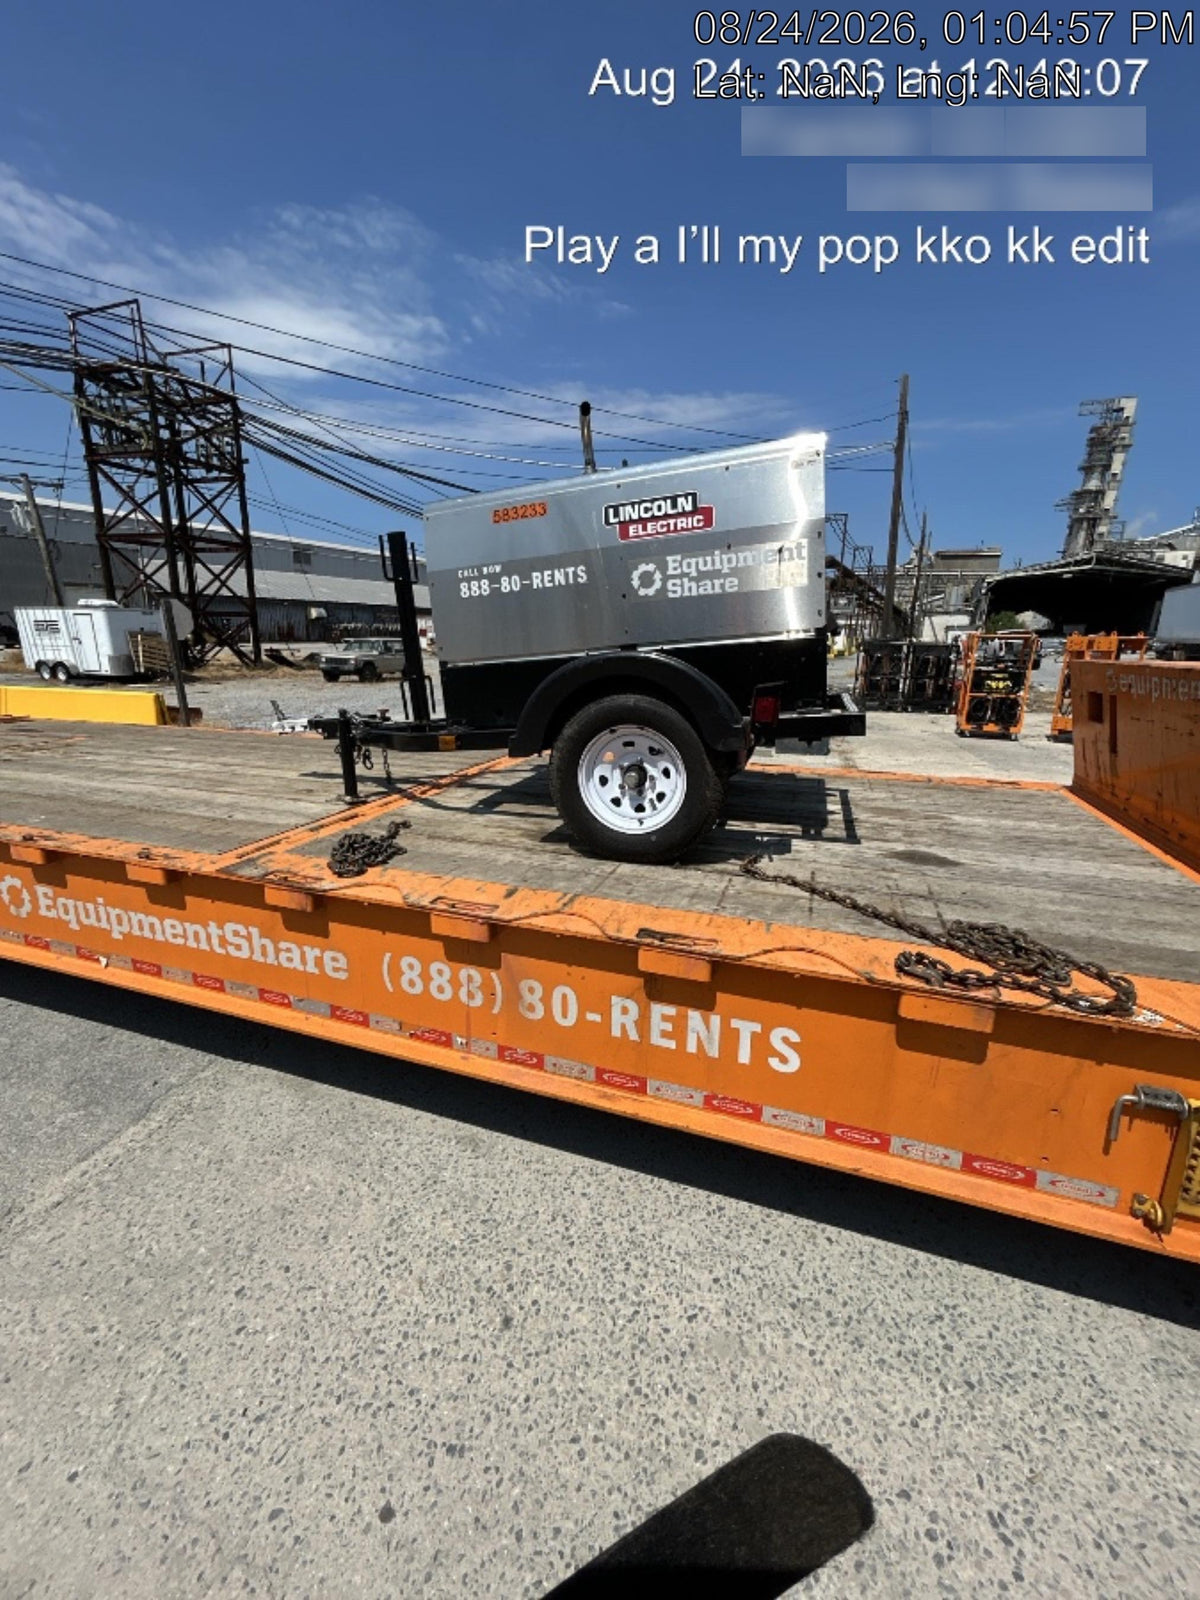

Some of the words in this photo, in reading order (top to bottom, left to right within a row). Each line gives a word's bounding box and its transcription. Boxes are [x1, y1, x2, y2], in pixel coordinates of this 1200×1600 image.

[492, 502, 548, 524] 583233
[608, 495, 693, 523] LINCOLN
[628, 514, 705, 537] ELECTRIC
[666, 542, 807, 577] Equipment
[458, 569, 479, 579] CALL
[460, 565, 588, 598] 888-80-RENTS
[666, 577, 739, 598] Share
[36, 885, 349, 980] EquipmentShare
[382, 952, 502, 1014] (888)
[518, 980, 802, 1073] 80-RENTS
